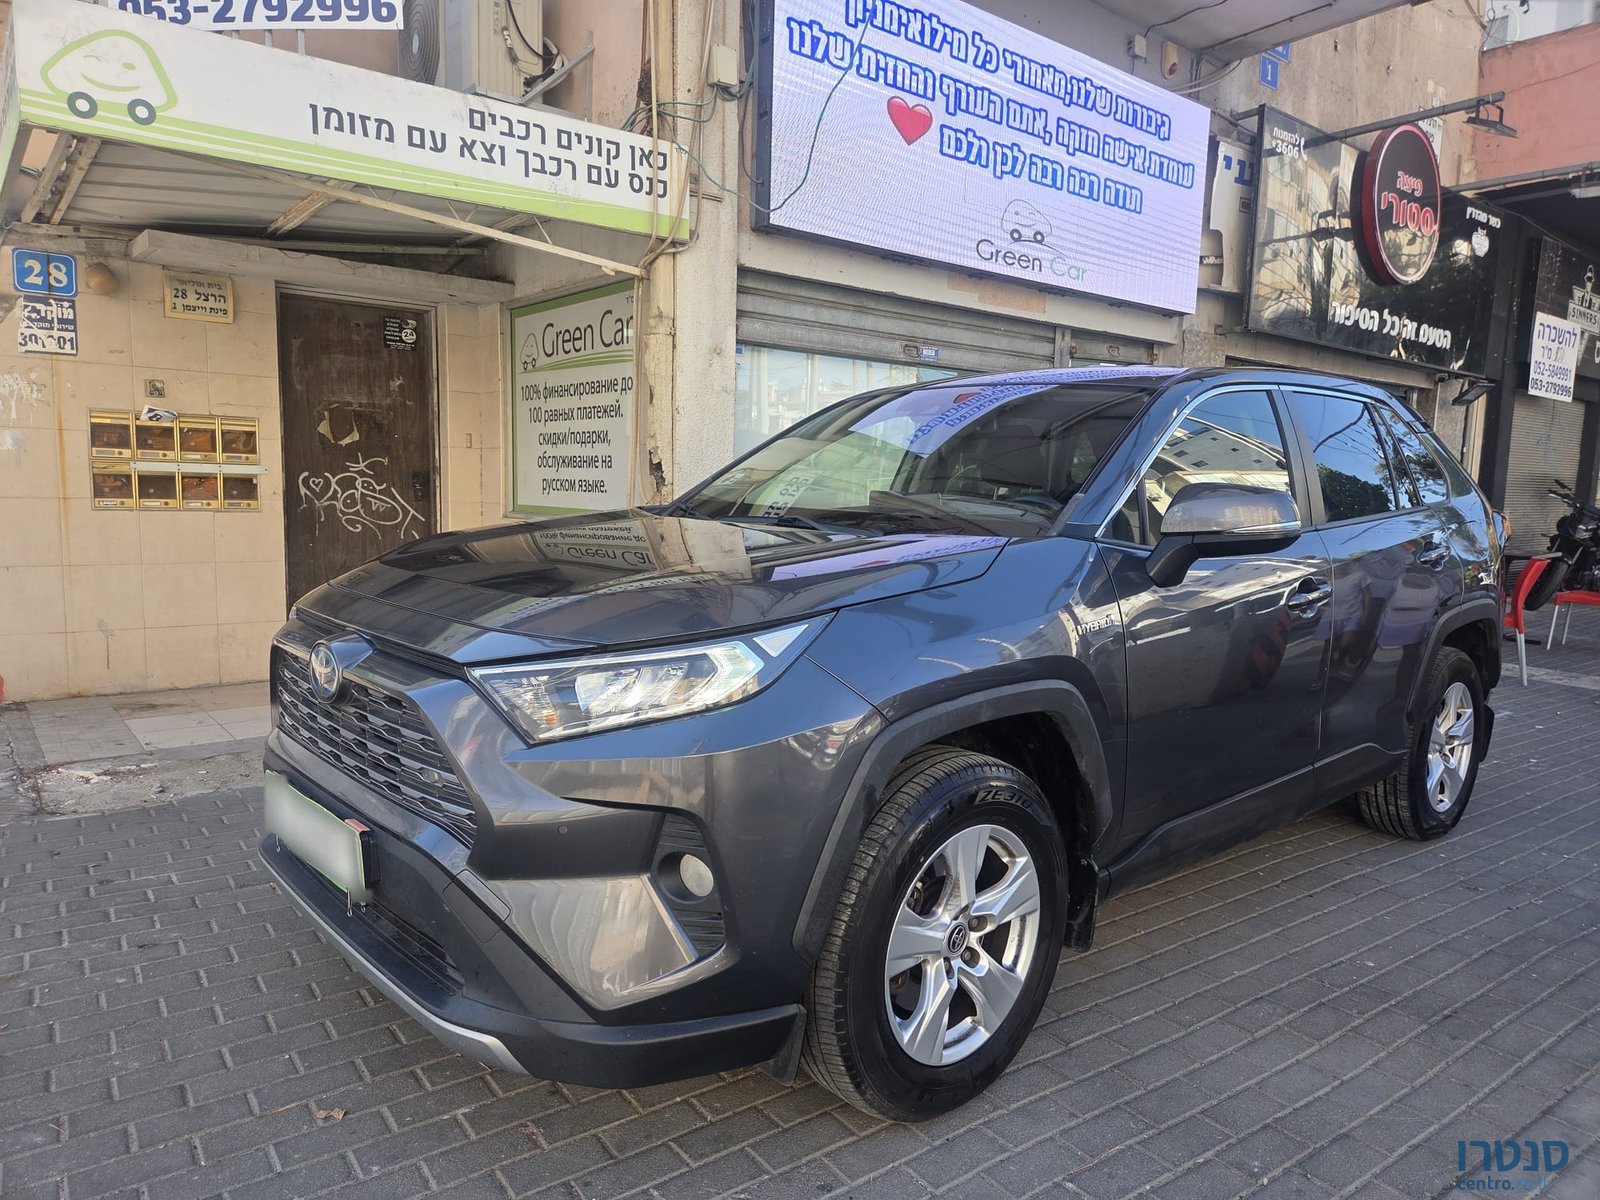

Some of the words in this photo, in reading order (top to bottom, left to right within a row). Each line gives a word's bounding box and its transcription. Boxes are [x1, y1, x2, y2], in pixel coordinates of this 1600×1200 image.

[786, 17, 854, 71] שלנו
[971, 30, 1000, 73] כל
[939, 73, 1003, 125] העורף
[309, 103, 395, 143] מזומן
[468, 108, 547, 145] רכבים
[1056, 117, 1100, 158] חזקה
[407, 125, 447, 154] עם
[459, 136, 506, 167] וצא
[556, 128, 621, 165] קונים
[939, 123, 989, 169] ולכם
[1102, 134, 1147, 174] אישה
[516, 148, 577, 181] רכבך
[629, 143, 668, 172] כאן
[992, 141, 1026, 180] לכן
[1029, 153, 1064, 191] רבה
[1148, 151, 1195, 189] עומדת
[587, 162, 619, 189] עם
[628, 172, 668, 199] כנס
[1067, 166, 1100, 202] רבה
[1103, 177, 1143, 214] תודה
[1381, 192, 1435, 236] סטורי
[24, 259, 68, 287] 28
[976, 239, 1042, 272] Green
[1050, 255, 1087, 281] Car
[173, 287, 188, 299] 28
[194, 289, 227, 304] הרצל
[208, 306, 228, 315] פינת
[1332, 301, 1380, 332] הסיפור
[1382, 308, 1400, 336] כל
[1571, 306, 1597, 325] SINNERS
[542, 322, 595, 358] Green
[600, 309, 634, 348] Car
[1419, 323, 1452, 350] הטעם
[1538, 322, 1578, 349] להשכרה
[521, 384, 542, 401] 100%
[543, 378, 619, 404] финансирование
[620, 375, 634, 396] до
[528, 406, 543, 424] 100
[544, 405, 575, 427] равных
[576, 399, 624, 420] платежей.
[538, 428, 612, 449] скидки/подарки,
[537, 451, 599, 473] обслуживание
[600, 454, 613, 469] на
[542, 478, 576, 495] русском
[577, 477, 608, 494] языке.
